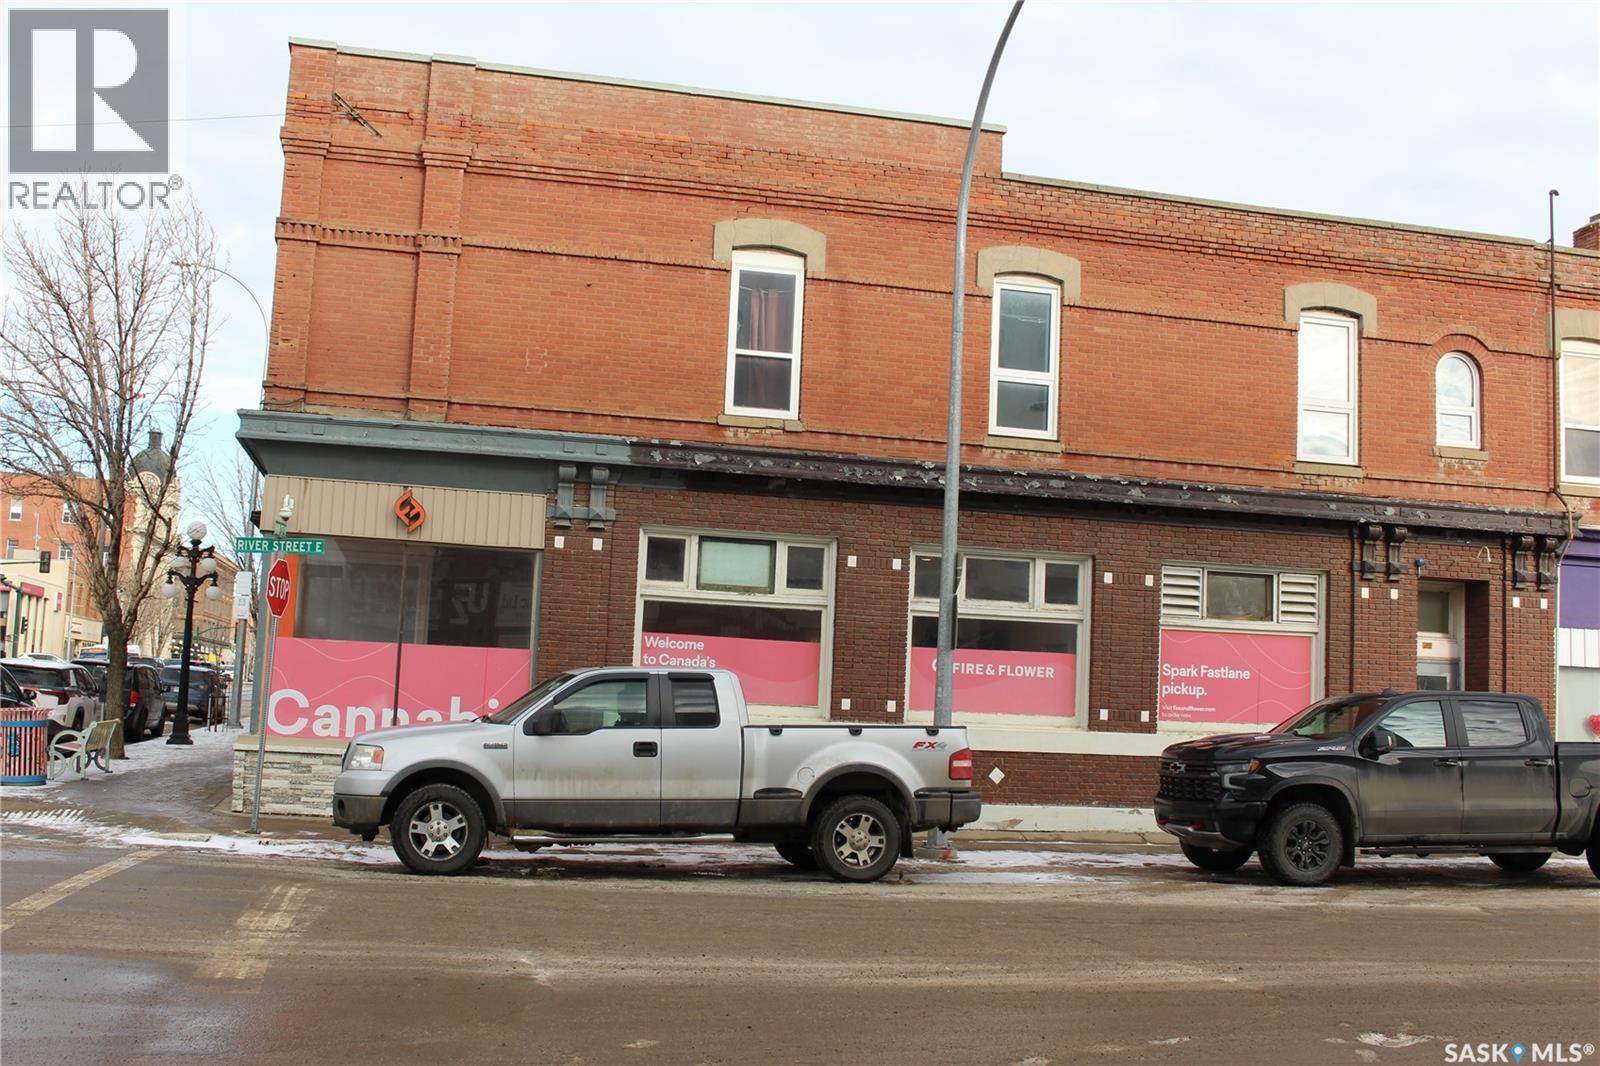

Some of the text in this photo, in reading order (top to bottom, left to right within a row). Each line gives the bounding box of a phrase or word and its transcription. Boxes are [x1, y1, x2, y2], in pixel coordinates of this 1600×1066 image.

[237, 540, 322, 552] RIVER STREET E
[269, 576, 290, 599] STOP
[644, 635, 705, 650] Welcome
[643, 654, 716, 668] to Canada's
[952, 662, 1055, 678] FIRE & FLOWER
[1162, 664, 1251, 680] Spark Fastlane
[1162, 682, 1207, 699] pickup.
